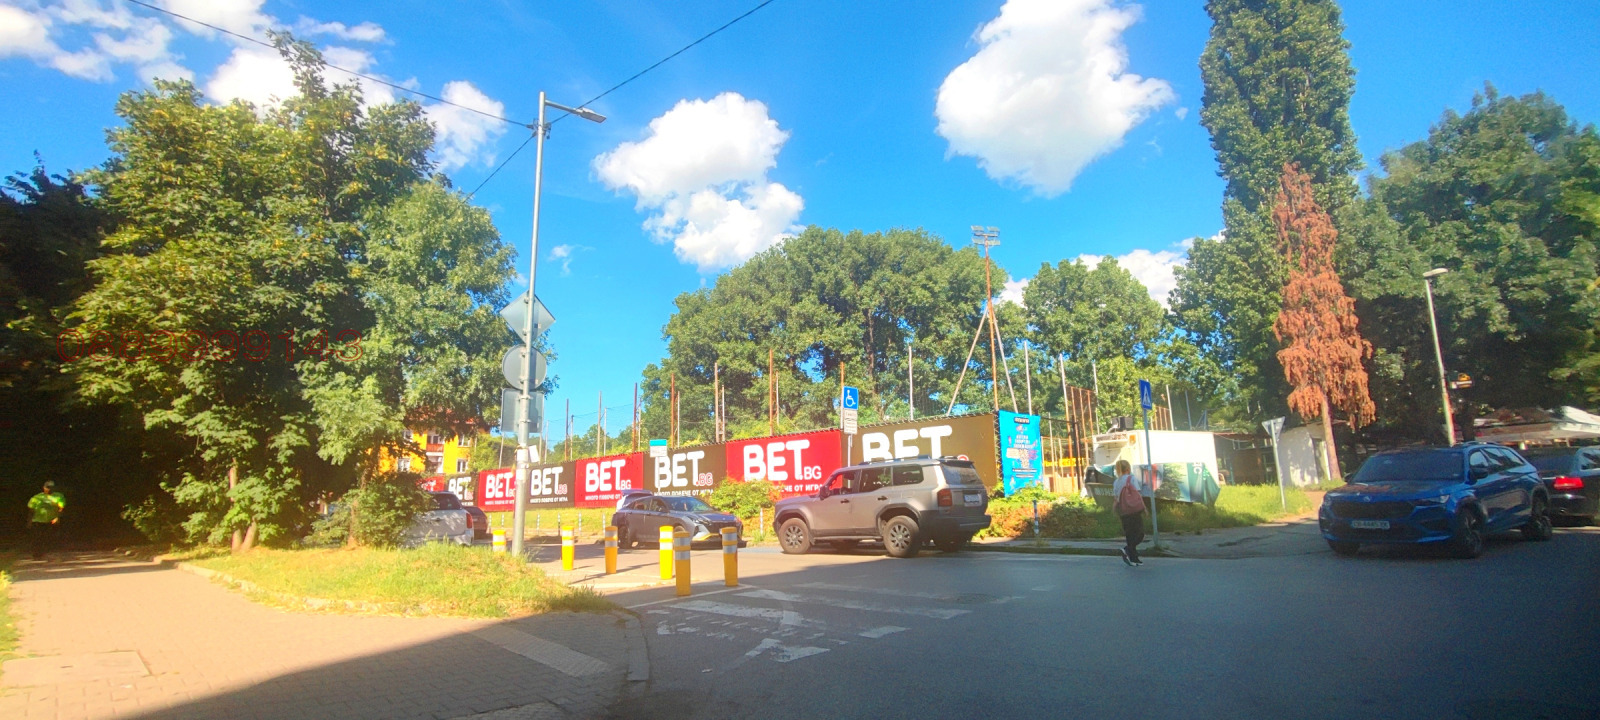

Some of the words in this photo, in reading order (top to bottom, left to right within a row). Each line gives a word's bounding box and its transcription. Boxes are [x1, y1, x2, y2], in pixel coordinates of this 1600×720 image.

[585, 459, 632, 492] BET.BG
[655, 450, 713, 488] BET.BG
[743, 439, 822, 482] BET.BG
